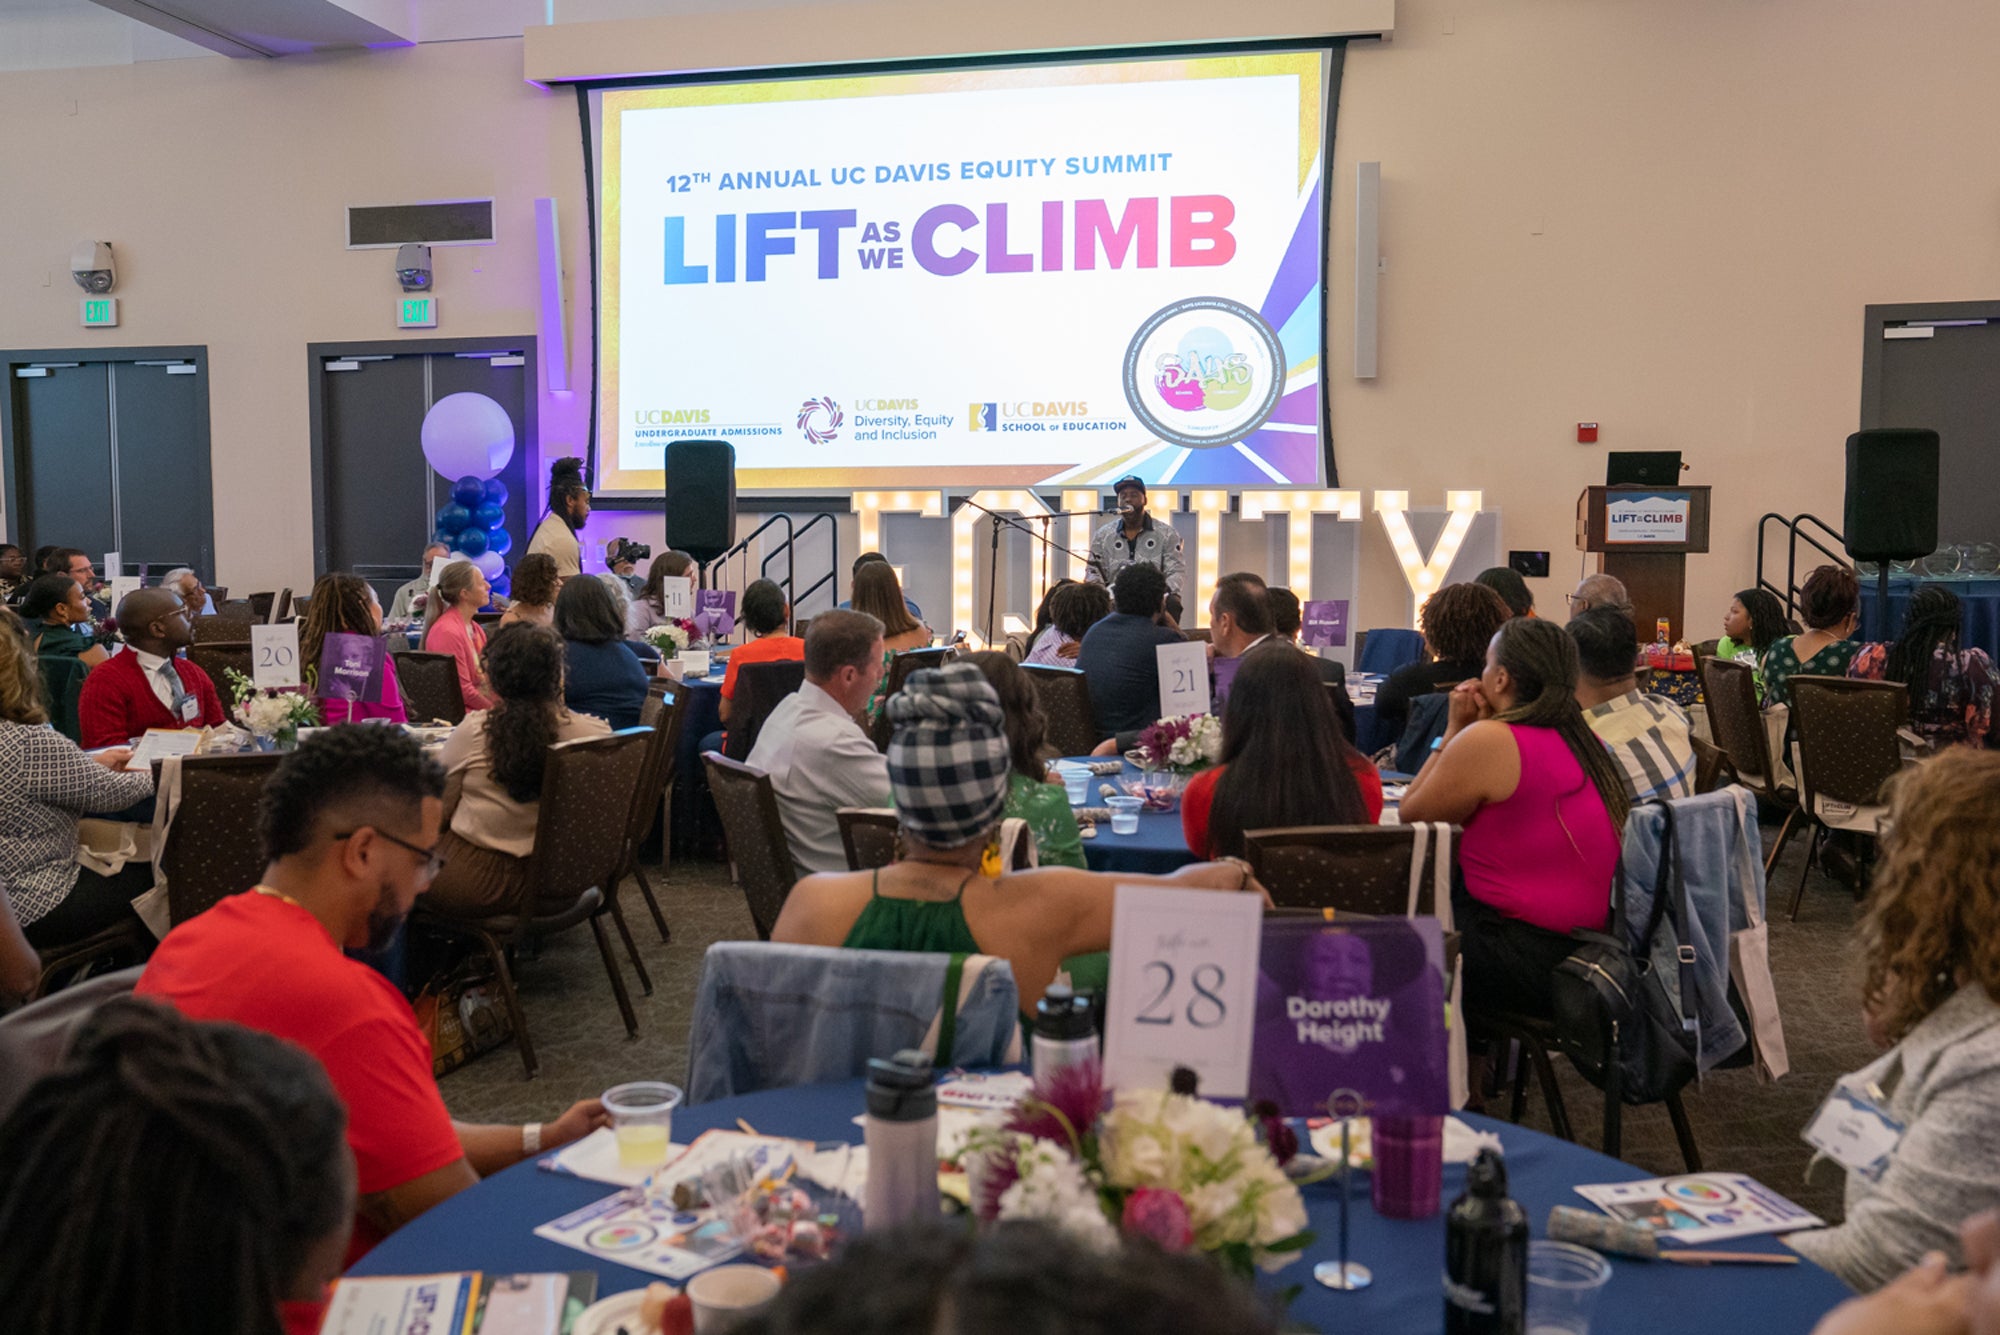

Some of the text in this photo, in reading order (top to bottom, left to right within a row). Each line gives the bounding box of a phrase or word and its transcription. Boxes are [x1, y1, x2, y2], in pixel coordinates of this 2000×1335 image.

[718, 168, 822, 191] ANNUAL
[831, 166, 866, 185] UC
[875, 163, 951, 184] DAVIS
[960, 157, 1057, 180] EQUITY
[1065, 152, 1173, 175] SUMMIT
[664, 194, 1237, 285] LIFT AS WE CLIMB
[86, 300, 111, 323] EXIT
[403, 299, 430, 323] EXIT
[635, 427, 783, 438] UNDERGRADUATE ADMISSIONS
[854, 414, 954, 428] Diversity, Equity
[1002, 422, 1046, 432] SCHOOL
[1063, 421, 1127, 431] EDUCATION
[854, 429, 937, 441] and Inclusion
[1611, 514, 1637, 523] LIFT
[1643, 514, 1683, 523] CLIMB
[260, 646, 293, 667] 20
[1172, 669, 1195, 693] 21
[1135, 960, 1226, 1029] 28
[1286, 995, 1391, 1023] Dorothy
[1297, 1020, 1385, 1049] Height
